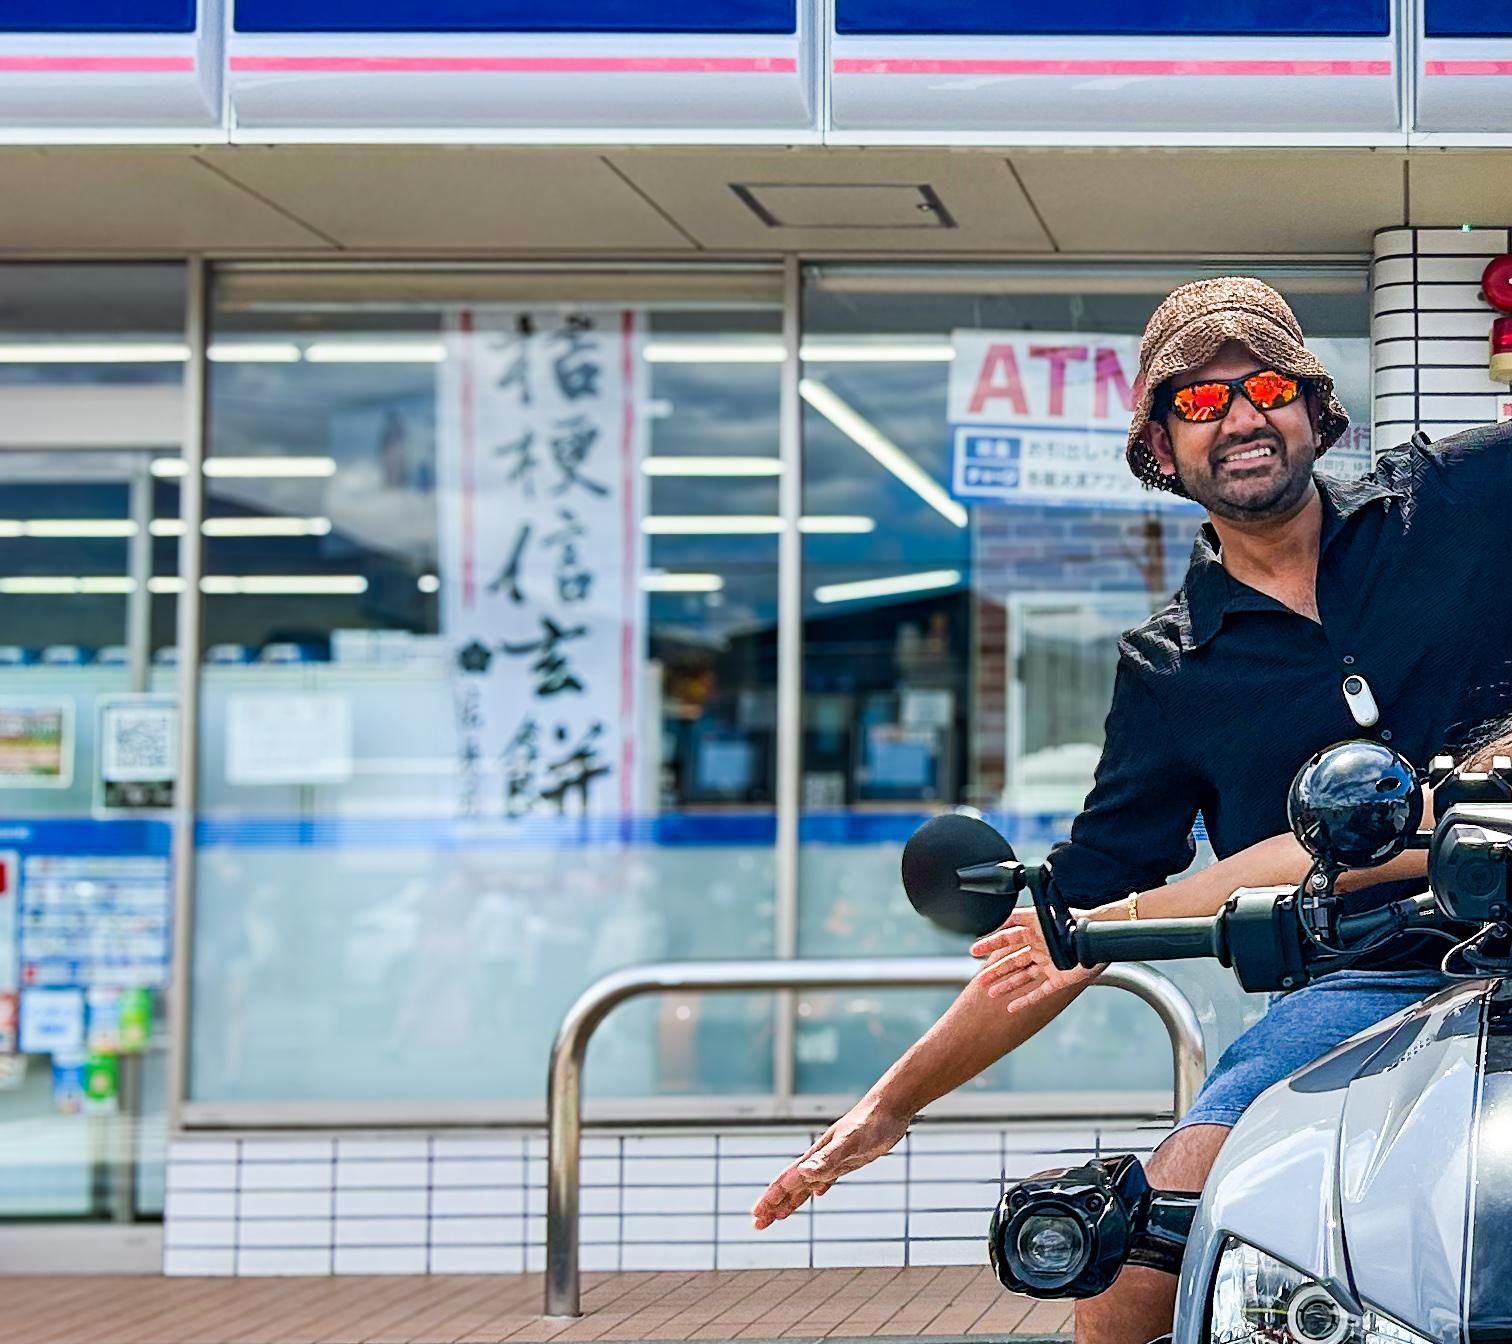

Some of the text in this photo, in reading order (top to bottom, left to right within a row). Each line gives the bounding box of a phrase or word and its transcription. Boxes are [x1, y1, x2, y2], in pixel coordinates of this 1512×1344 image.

[488, 311, 610, 843] 桔梗信玄餅
